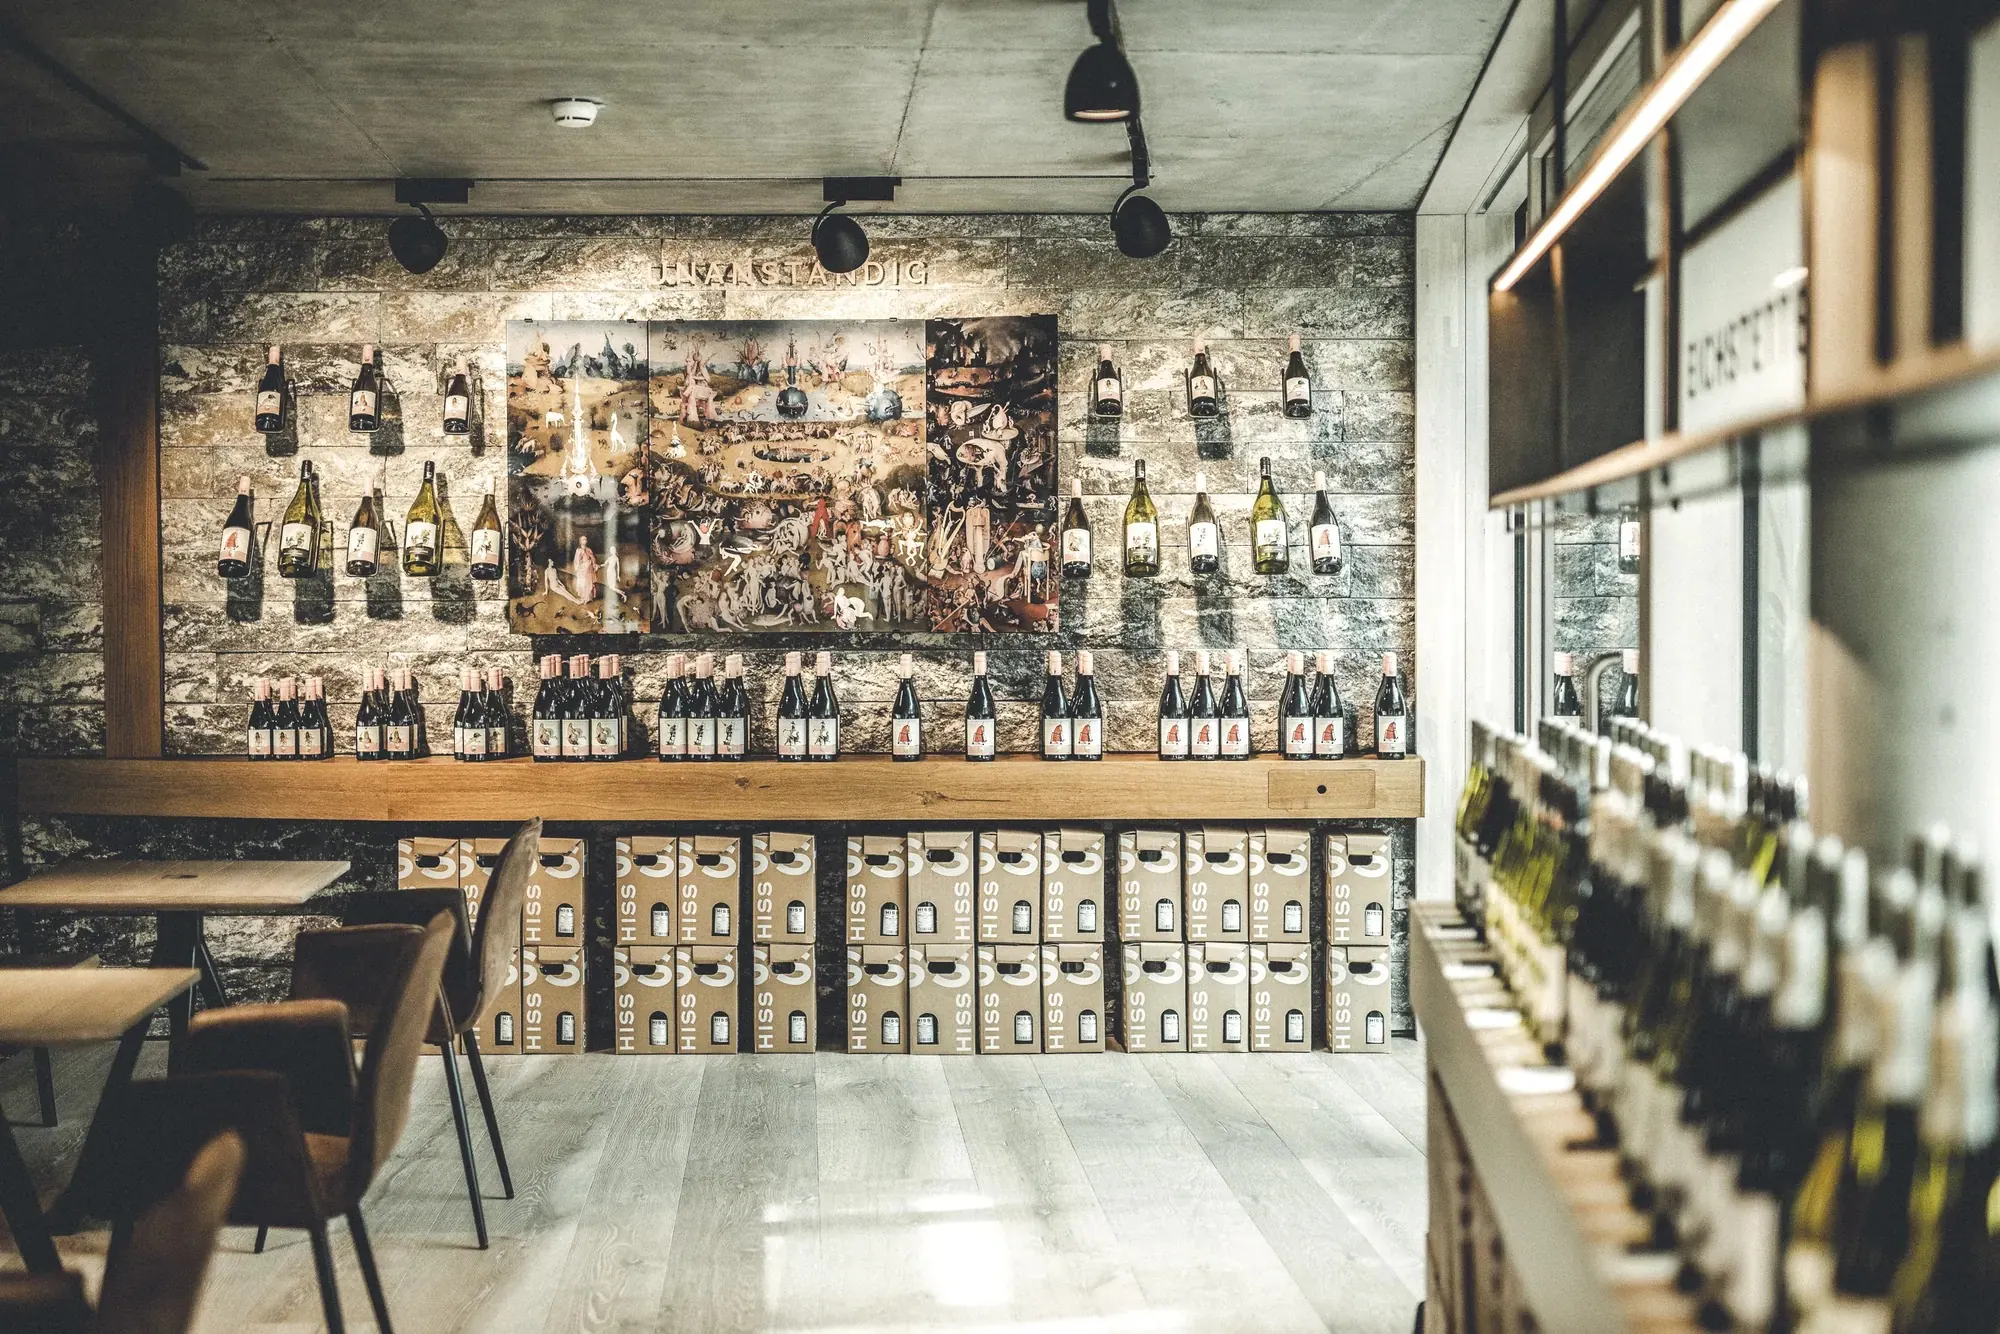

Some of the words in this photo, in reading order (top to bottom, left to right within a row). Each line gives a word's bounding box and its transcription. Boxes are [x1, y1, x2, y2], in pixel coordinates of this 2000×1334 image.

[526, 885, 541, 941] HISS
[621, 885, 636, 940] HISS
[682, 885, 697, 940] HISS
[757, 882, 772, 938] HISS
[851, 884, 866, 940] HISS
[954, 882, 970, 940] HISS
[983, 882, 998, 937] HISS
[1048, 882, 1063, 937] HISS
[1125, 881, 1140, 936] HISS
[1192, 882, 1207, 937] HISS
[1254, 883, 1269, 937] HISS
[1335, 885, 1350, 940] HISS
[527, 993, 541, 1049] HISS
[619, 994, 634, 1050] HISS
[681, 994, 697, 1051] HISS
[759, 992, 773, 1048] HISS
[852, 994, 867, 1049] HISS
[956, 994, 971, 1051] HISS
[985, 993, 999, 1049] HISS
[1048, 993, 1063, 1048] HISS
[1131, 992, 1145, 1047] HISS
[1193, 991, 1208, 1047] HISS
[1256, 991, 1270, 1047] HISS
[1336, 993, 1350, 1048] HISS
